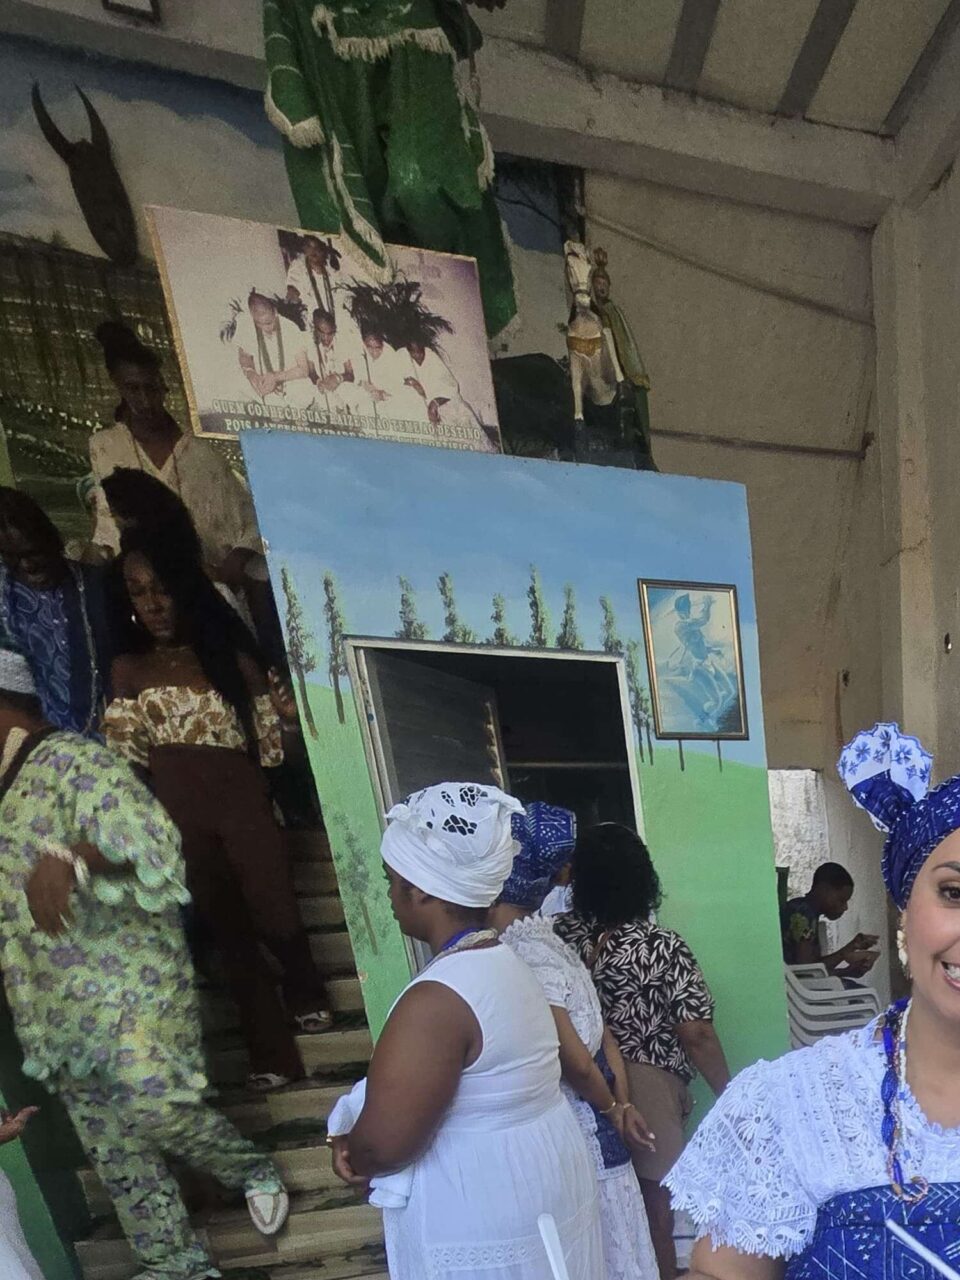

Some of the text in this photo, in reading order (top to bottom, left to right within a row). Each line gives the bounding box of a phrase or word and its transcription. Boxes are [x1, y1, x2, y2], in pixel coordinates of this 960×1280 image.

[213, 400, 245, 414] QUEM
[248, 402, 300, 420] CONHECE
[301, 408, 327, 424] SUAS
[437, 423, 481, 440] DESTINO
